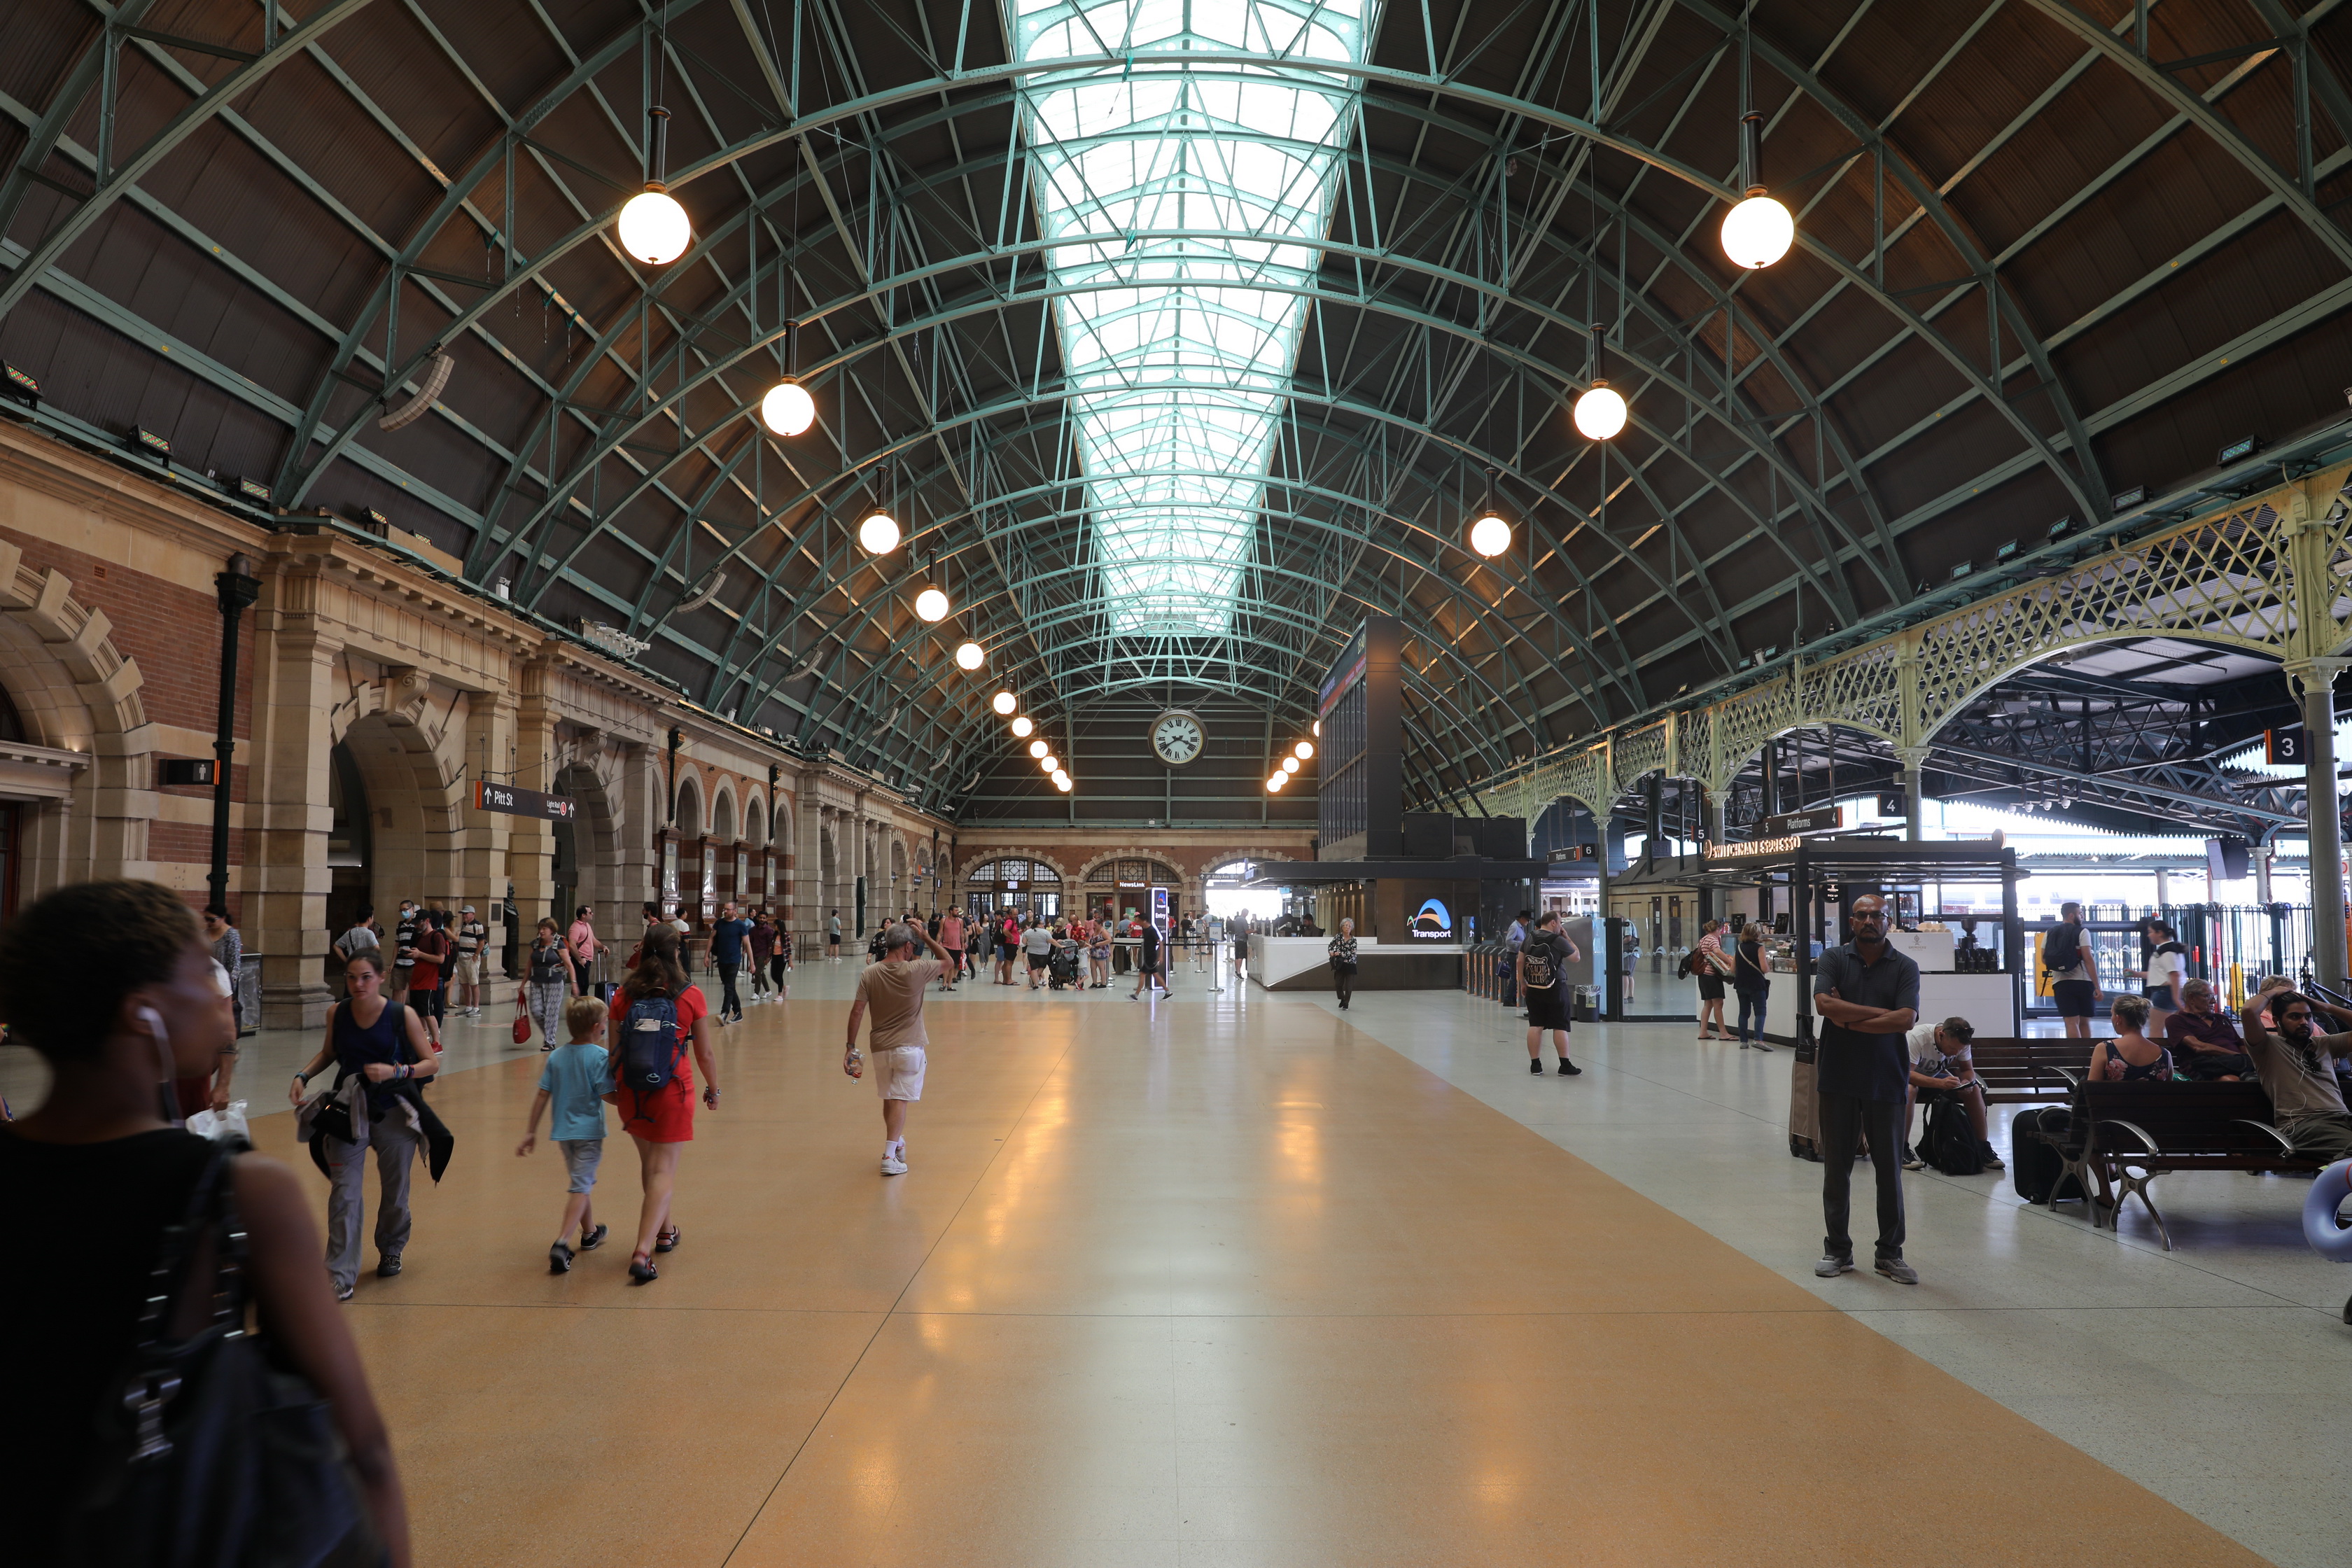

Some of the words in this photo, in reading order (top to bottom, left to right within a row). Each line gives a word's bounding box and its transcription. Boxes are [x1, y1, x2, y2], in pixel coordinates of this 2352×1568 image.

[2282, 737, 2295, 757] 3
[494, 790, 506, 805] Pitt
[506, 793, 513, 806] St
[1886, 799, 1896, 812] 4
[1765, 822, 1769, 832] 5
[1787, 818, 1811, 830] Platforms
[1832, 812, 1836, 823] 4
[1698, 830, 1704, 839] 5
[1713, 841, 1758, 858] SWITCHMAN
[1760, 836, 1801, 853] ESPRESSO
[1412, 929, 1451, 939] Transport
